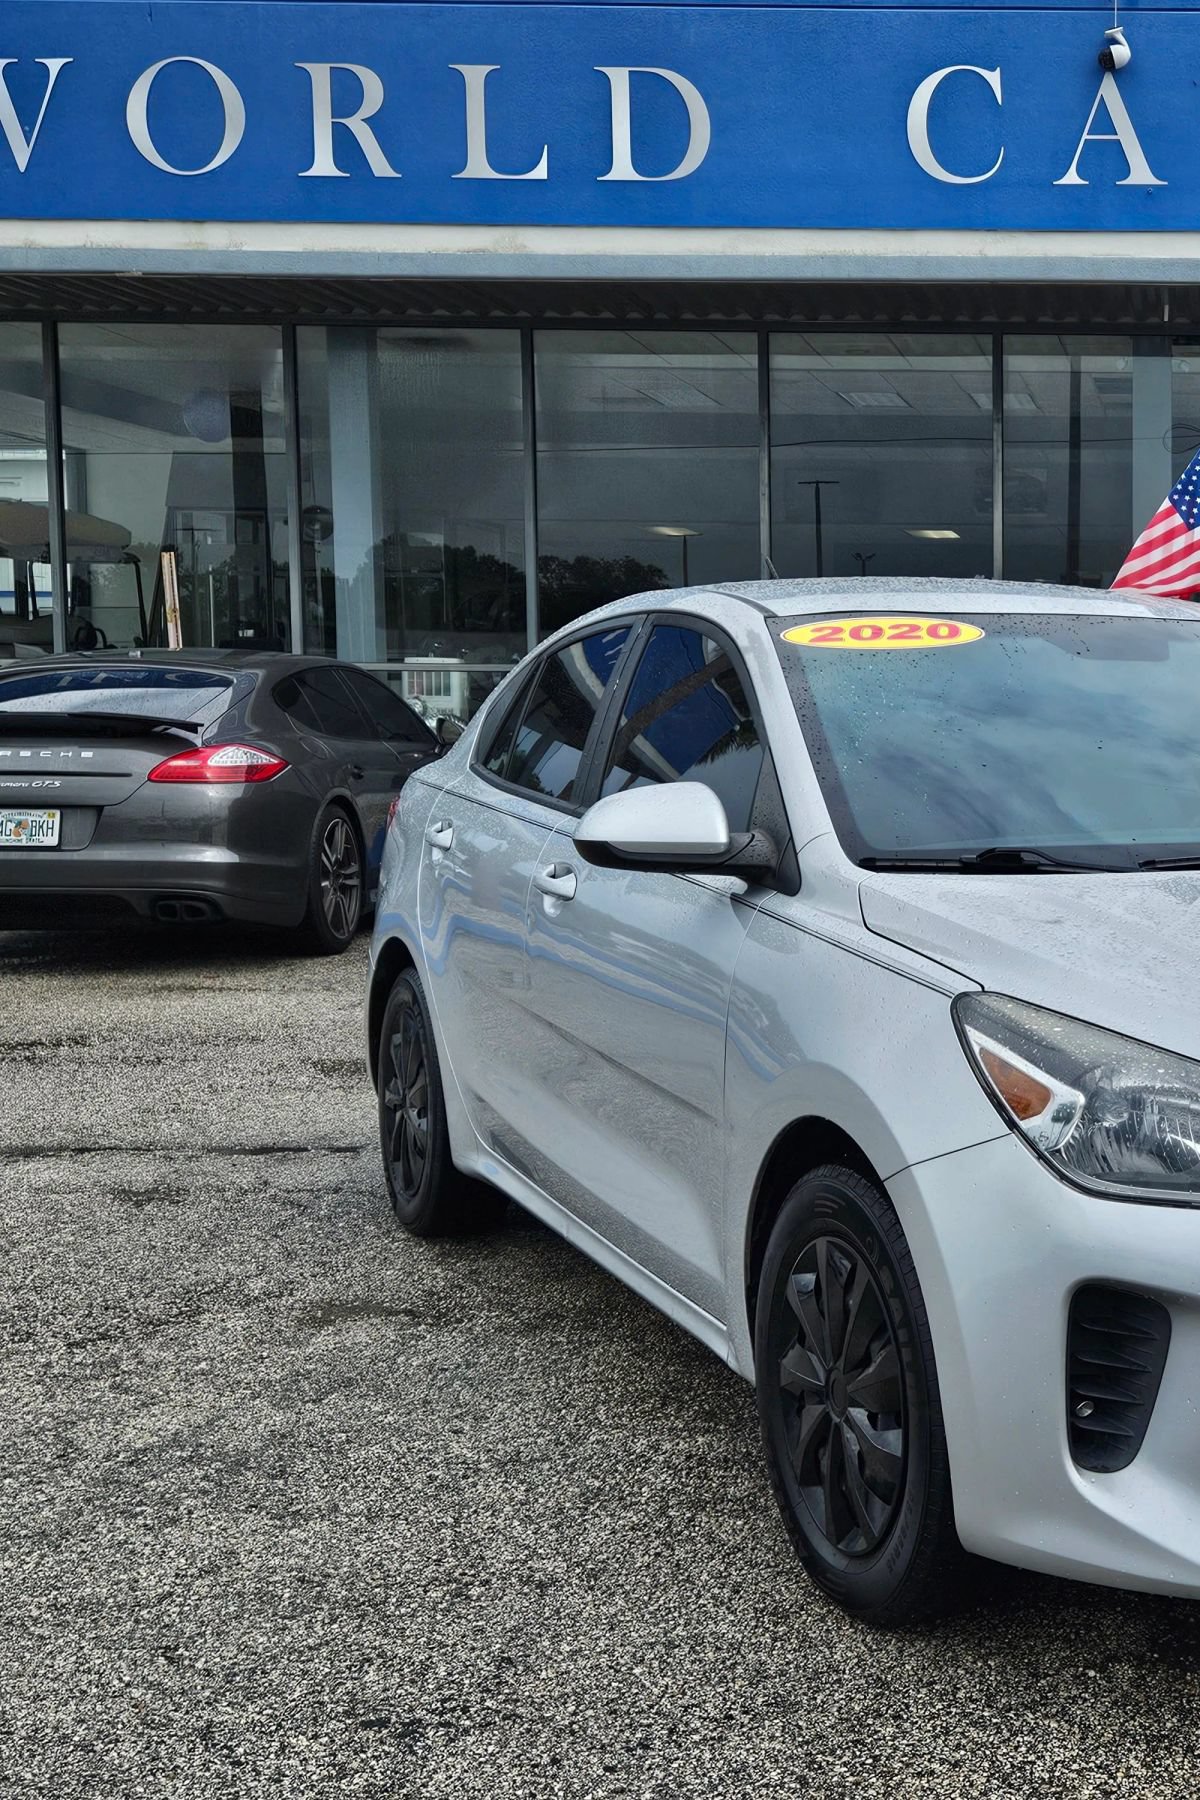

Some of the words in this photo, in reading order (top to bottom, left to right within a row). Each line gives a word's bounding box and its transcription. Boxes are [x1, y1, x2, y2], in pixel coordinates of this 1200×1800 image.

[808, 623, 961, 643] 2020
[31, 780, 62, 788] GTS
[30, 820, 54, 837] BKH
